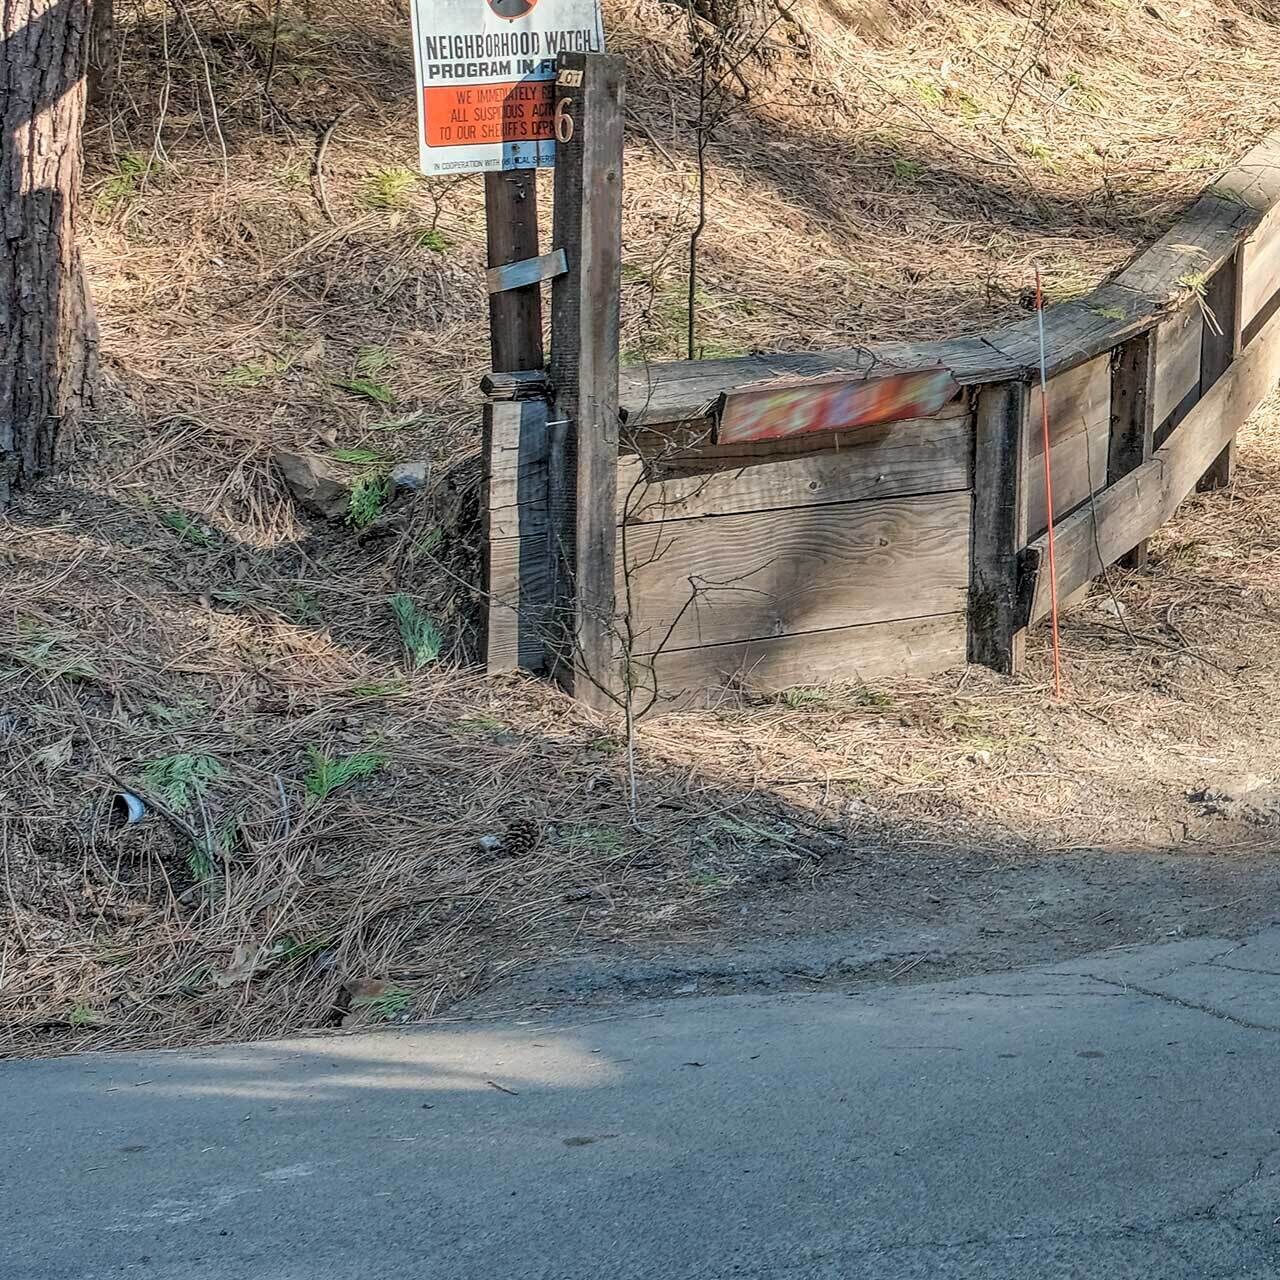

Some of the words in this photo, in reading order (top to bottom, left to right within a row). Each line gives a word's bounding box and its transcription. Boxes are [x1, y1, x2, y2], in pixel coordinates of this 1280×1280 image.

[425, 31, 541, 61] NEIGHBORHOOD
[545, 29, 591, 55] WATCH
[428, 60, 511, 80] PROGRAM
[516, 59, 534, 75] IN
[456, 90, 472, 104] WE
[477, 86, 537, 103] IMMEDIATELY
[450, 108, 469, 123] ALL
[474, 103, 525, 121] SUSPIOUS
[554, 97, 574, 143] 6
[440, 126, 451, 141] TO
[457, 125, 476, 140] OUR
